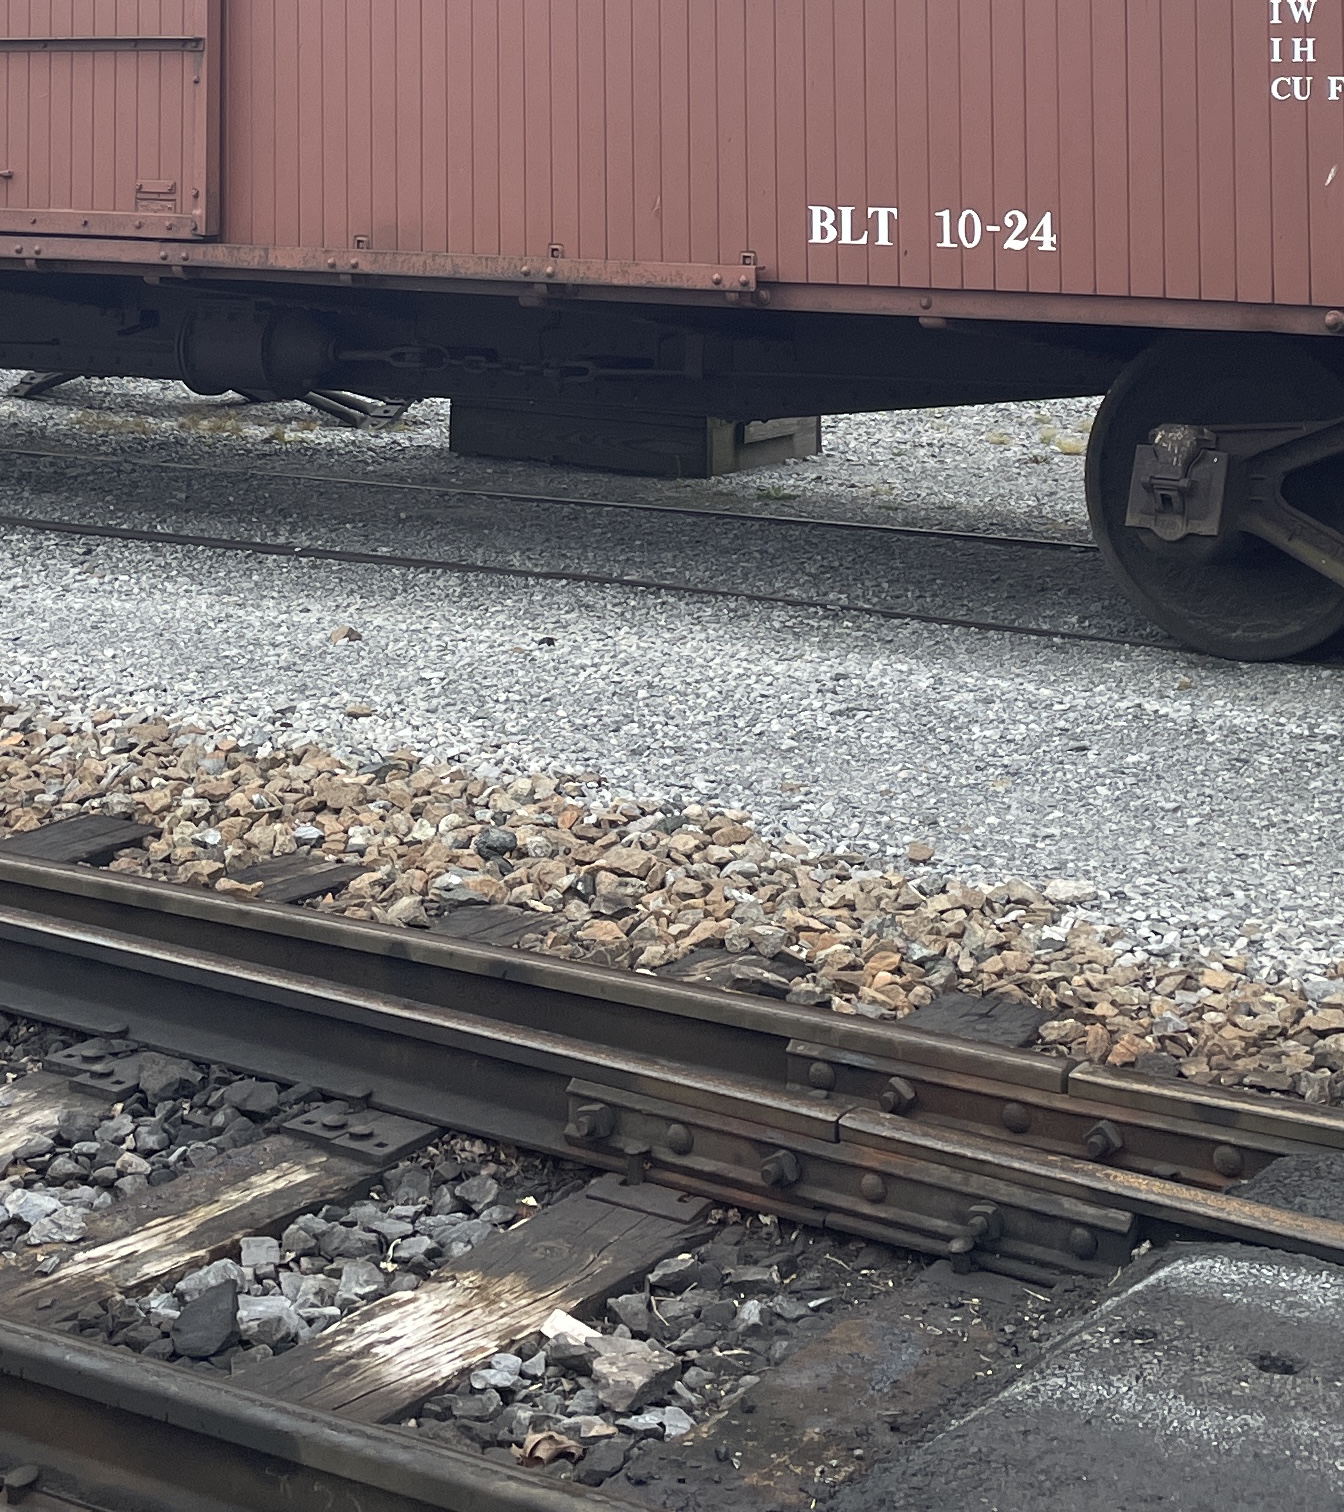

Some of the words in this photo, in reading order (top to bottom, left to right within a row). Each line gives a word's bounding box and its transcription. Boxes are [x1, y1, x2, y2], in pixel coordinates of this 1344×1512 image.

[1270, 76, 1314, 101] CU
[807, 205, 898, 246] BLT
[934, 209, 1057, 252] 10-24
